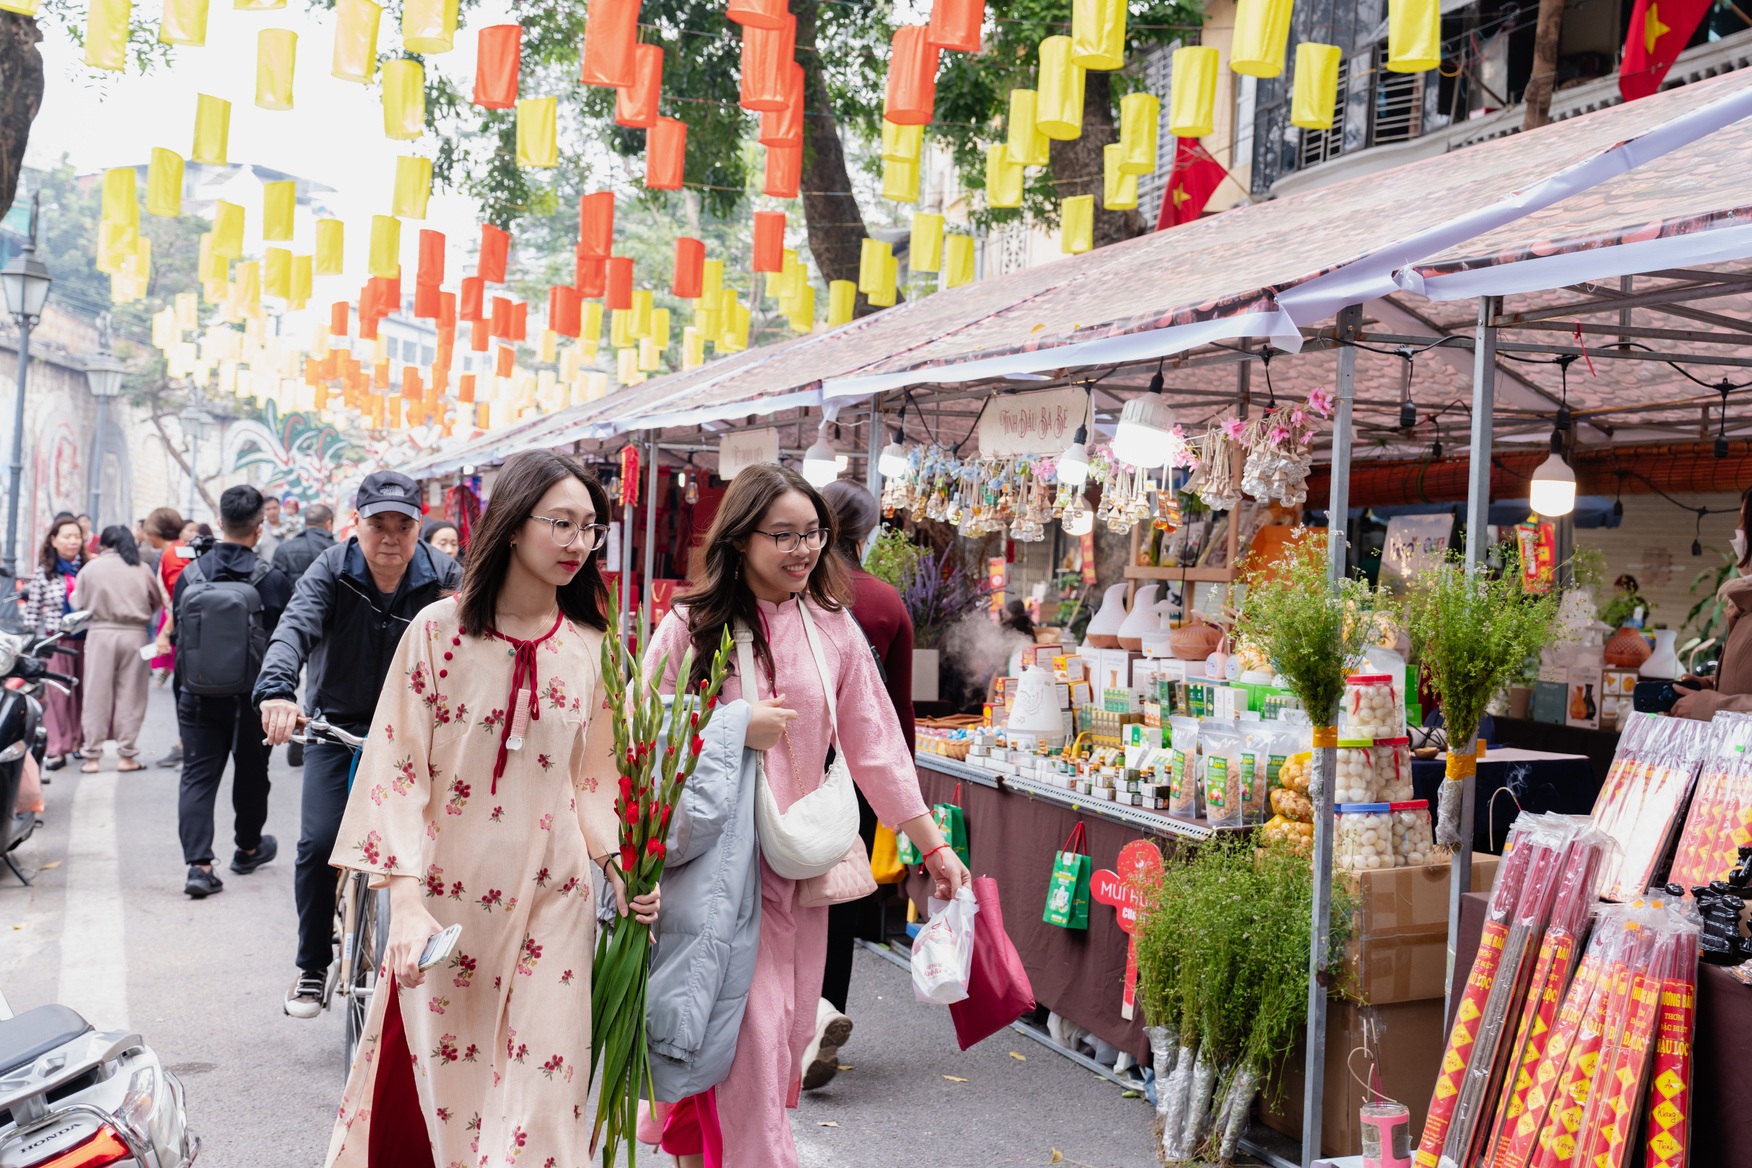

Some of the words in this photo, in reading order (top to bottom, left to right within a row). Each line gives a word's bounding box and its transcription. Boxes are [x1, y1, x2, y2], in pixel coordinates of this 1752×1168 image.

[1100, 880, 1126, 902] MÙI
[1664, 1012, 1684, 1022] THƠM
[1673, 1037, 1690, 1060] LỘC
[1657, 1106, 1677, 1123] Khang
[20, 1123, 84, 1154] HONDA
